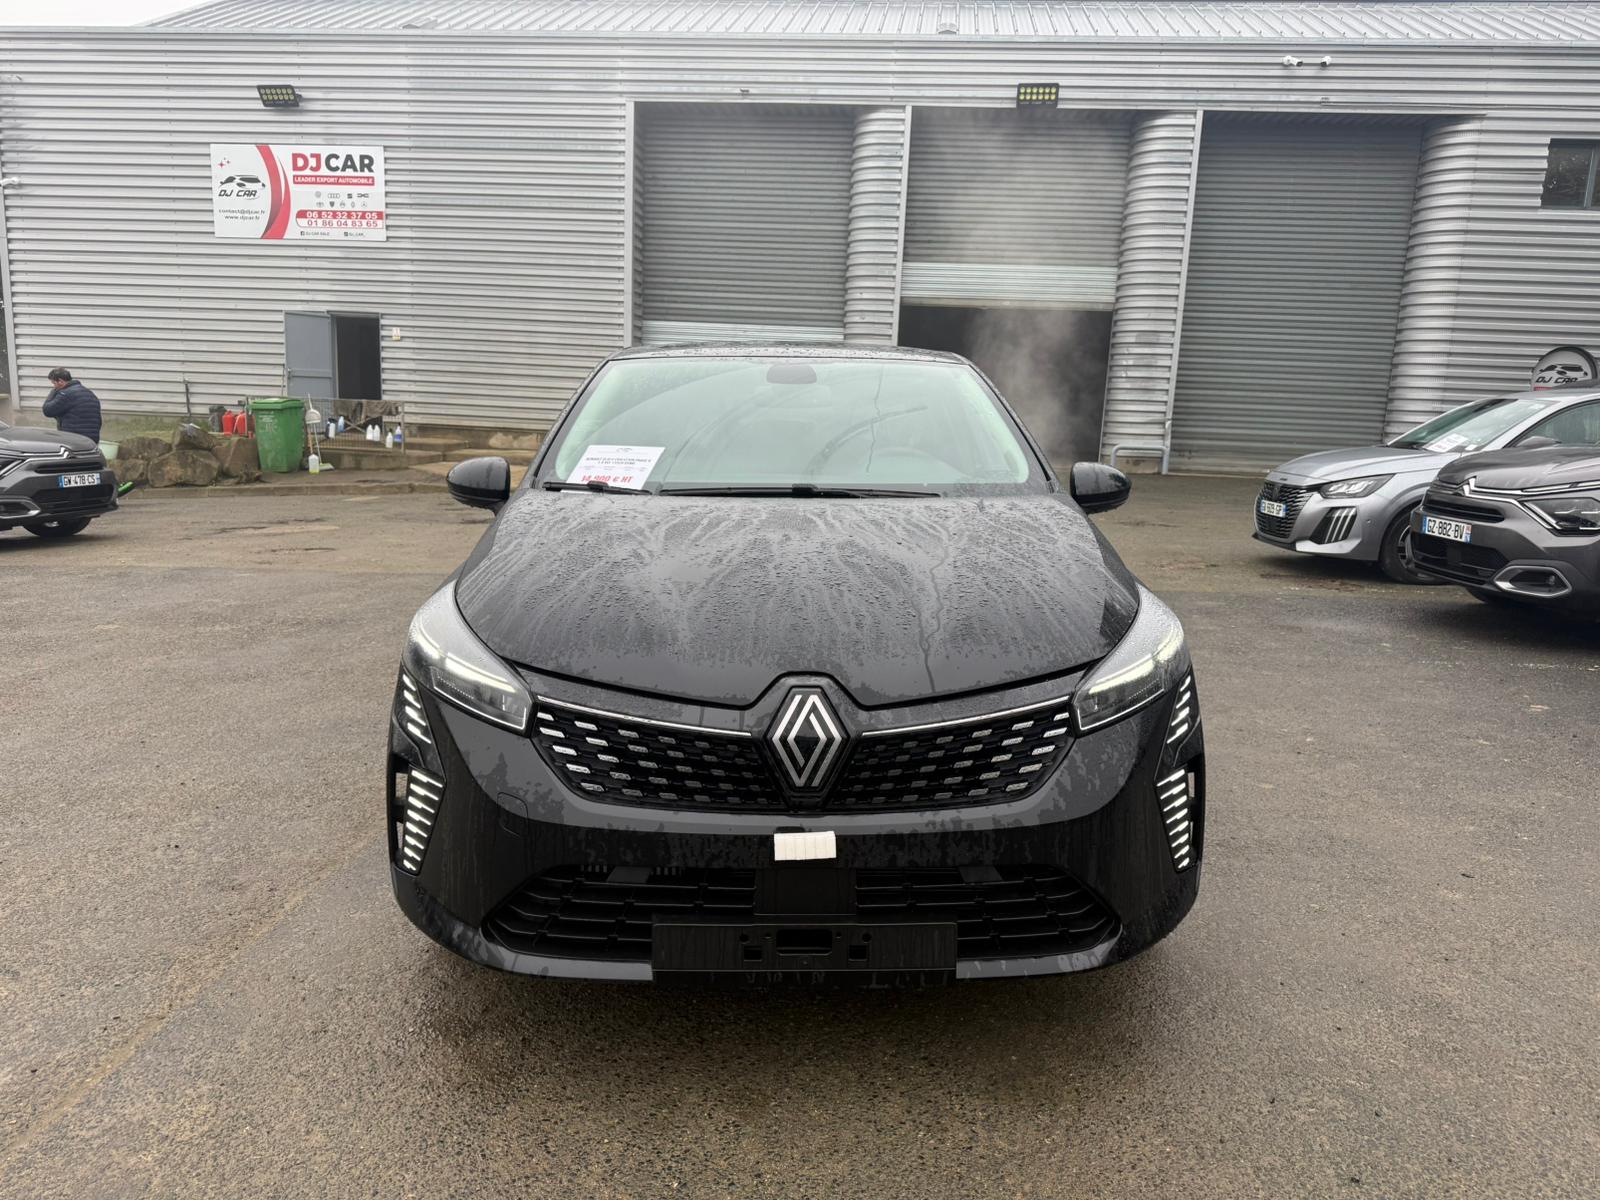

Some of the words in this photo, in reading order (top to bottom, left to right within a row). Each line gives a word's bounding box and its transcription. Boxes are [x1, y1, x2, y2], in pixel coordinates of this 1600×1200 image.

[218, 189, 234, 197] DJ
[236, 189, 258, 198] CAR
[321, 211, 333, 219] 52
[365, 212, 378, 220] 05
[1427, 518, 1465, 540] GZ-882-BV
